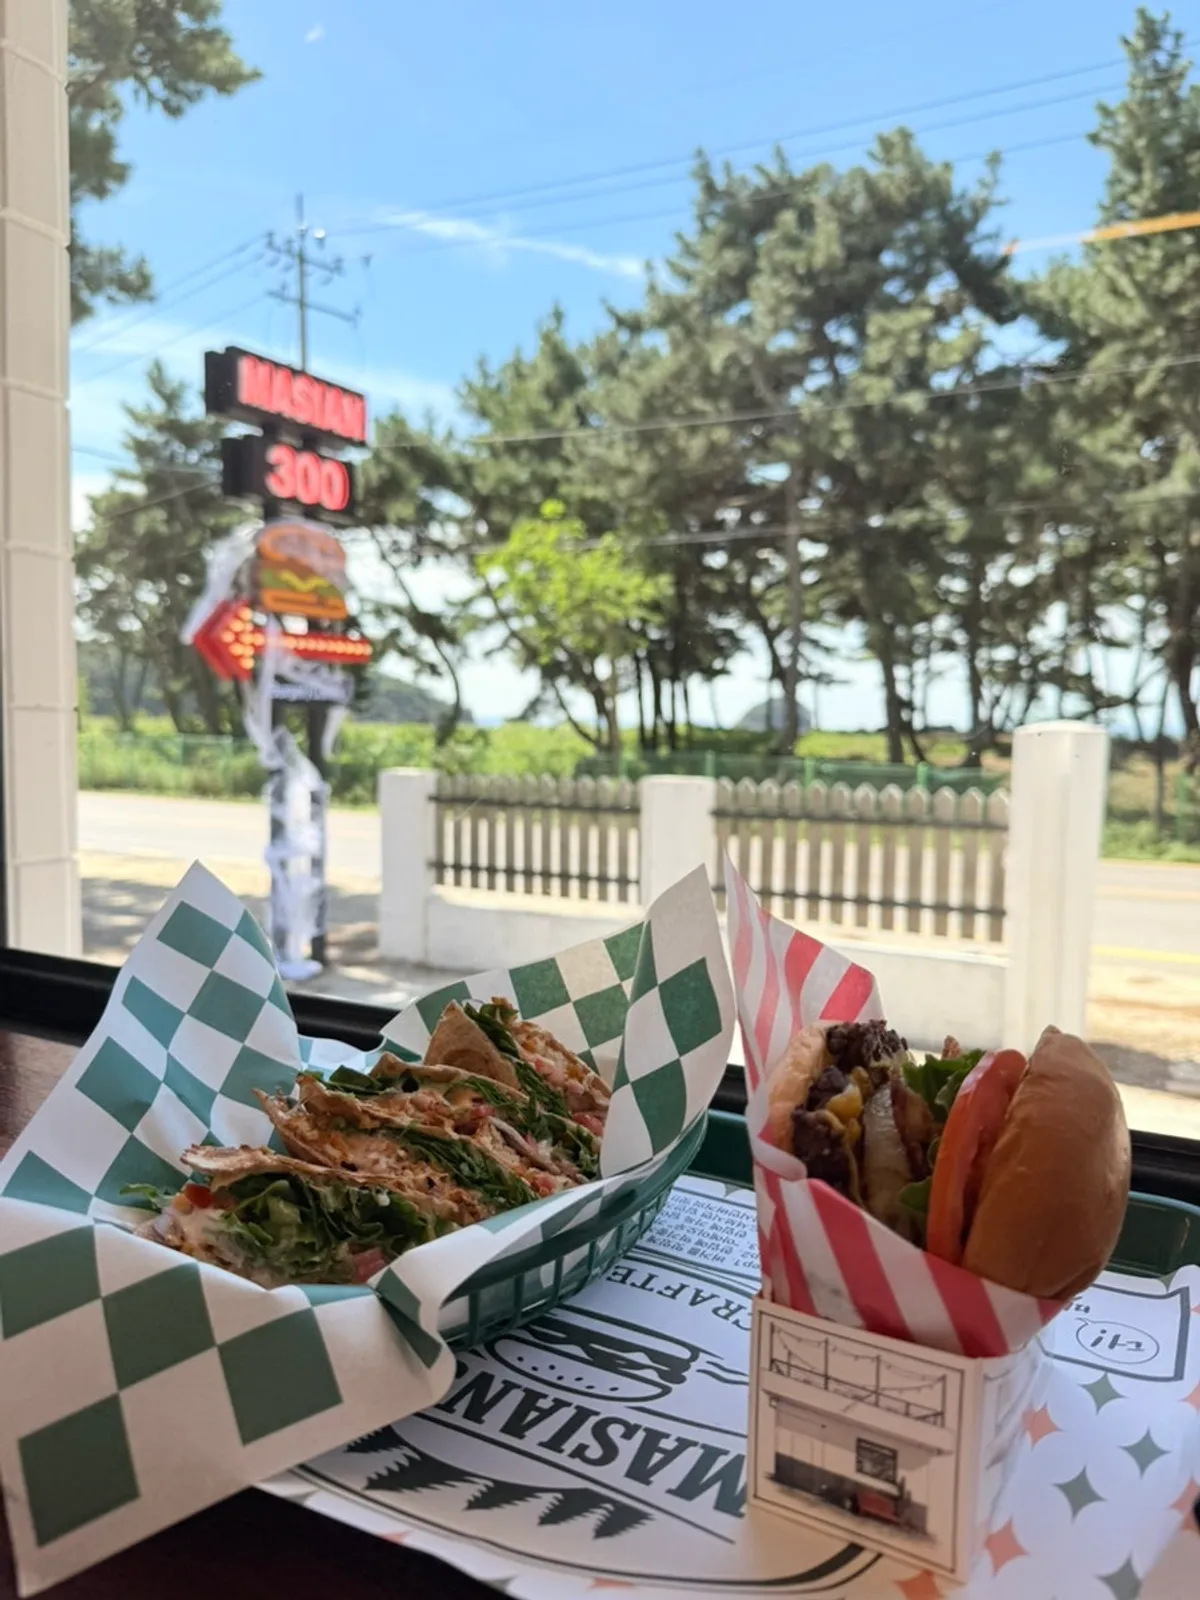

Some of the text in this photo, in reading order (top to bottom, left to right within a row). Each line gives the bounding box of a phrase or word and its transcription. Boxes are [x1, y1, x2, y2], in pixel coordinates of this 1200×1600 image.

[238, 354, 365, 442] MASIAN
[264, 444, 349, 511] 300
[605, 1264, 752, 1332] CRAFTE
